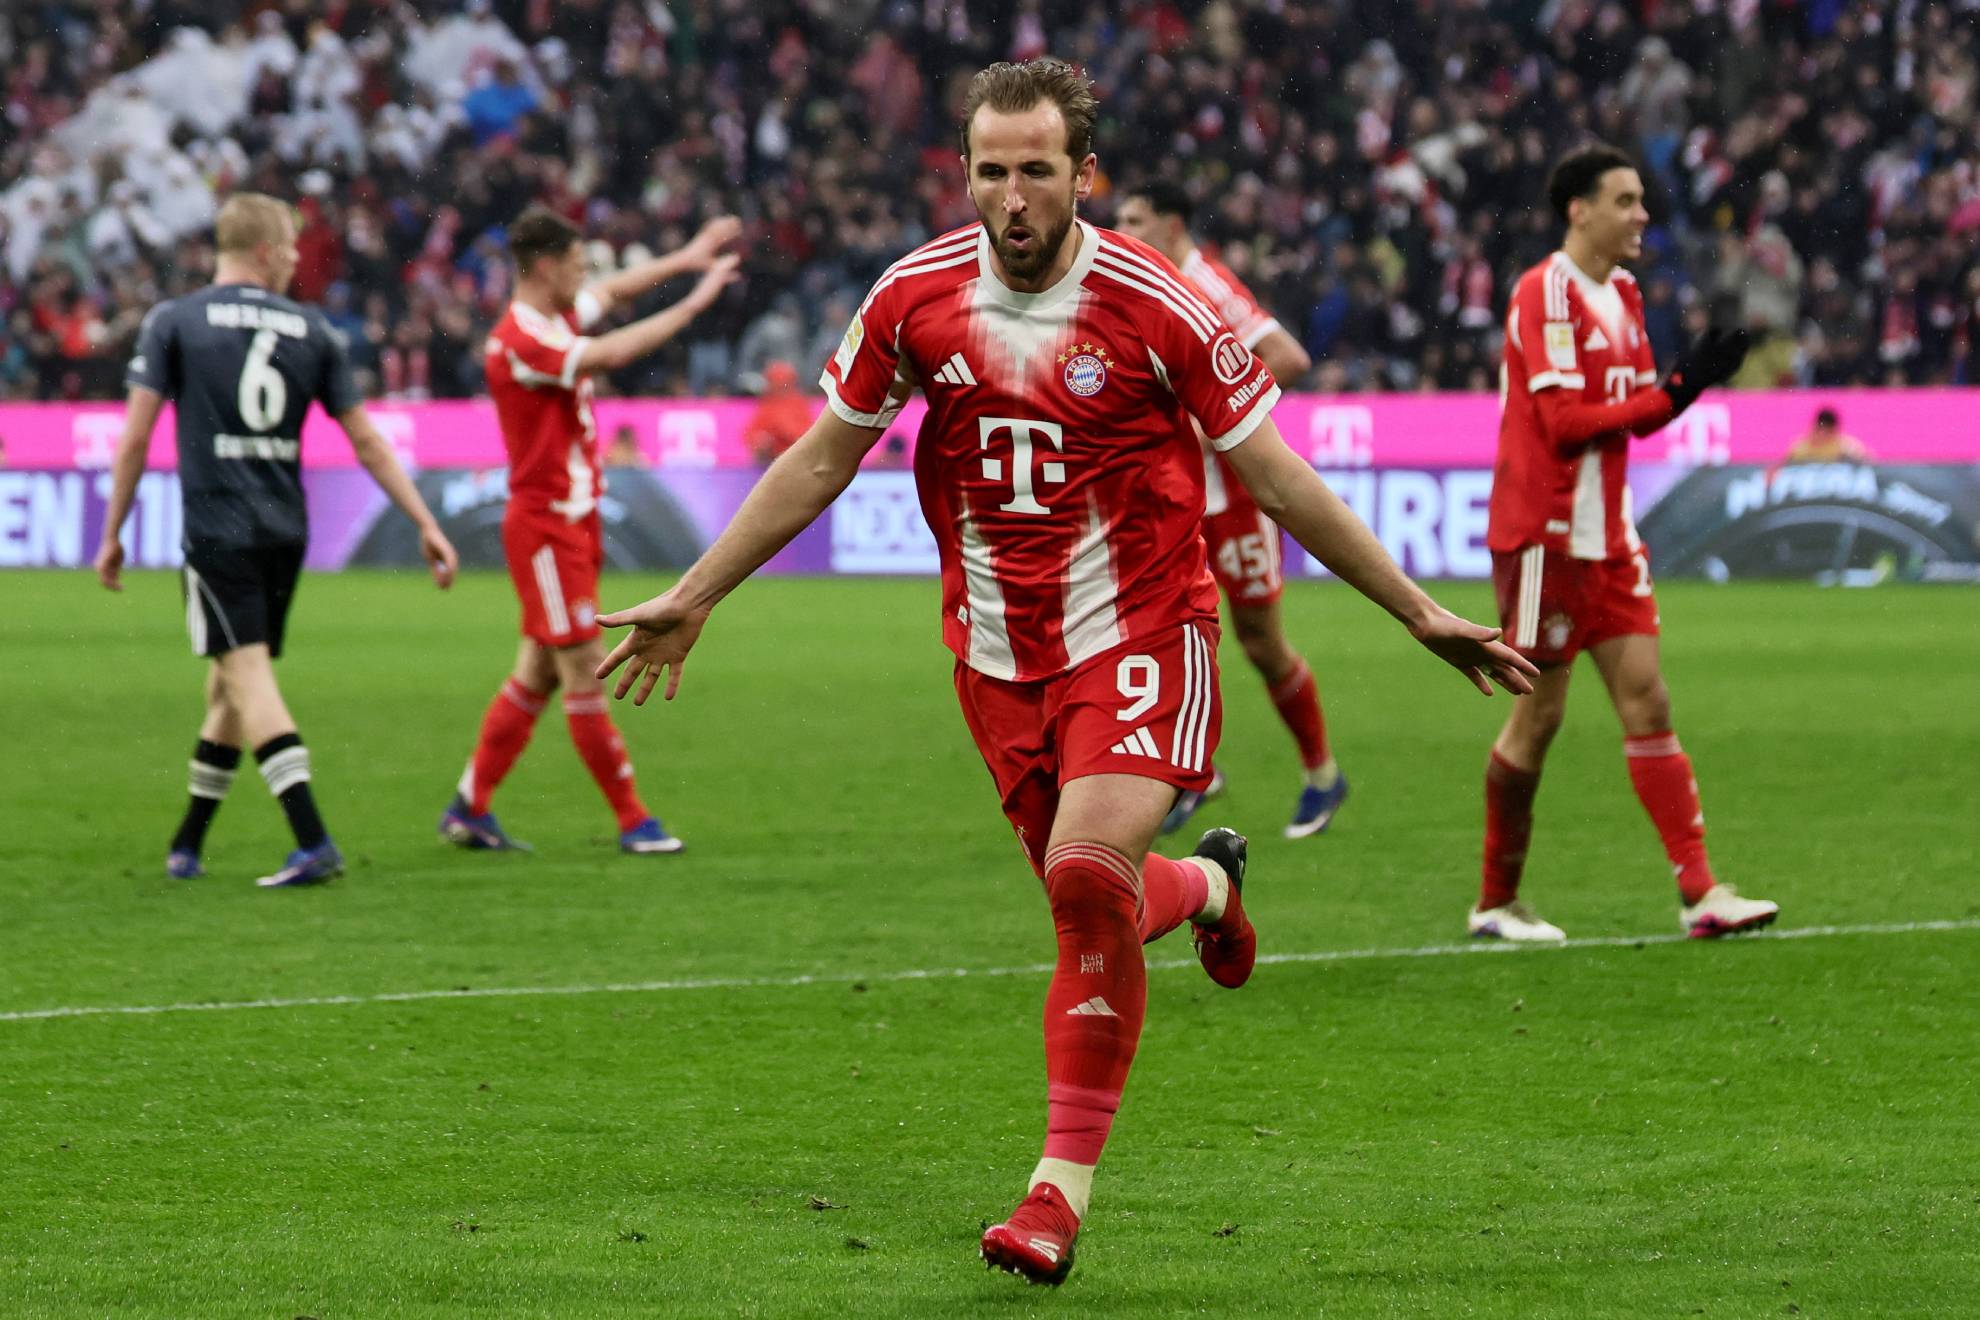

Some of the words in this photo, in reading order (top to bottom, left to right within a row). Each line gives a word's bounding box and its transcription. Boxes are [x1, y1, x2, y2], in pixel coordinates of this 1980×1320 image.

[238, 330, 287, 432] 6
[1067, 378, 1102, 394] MÜNCHEN
[1068, 361, 1078, 372] FC
[1077, 358, 1103, 375] BAYERN
[1227, 368, 1269, 413] Allianz
[978, 416, 1066, 514] T
[1217, 533, 1269, 580] 45
[1116, 654, 1160, 722] 9
